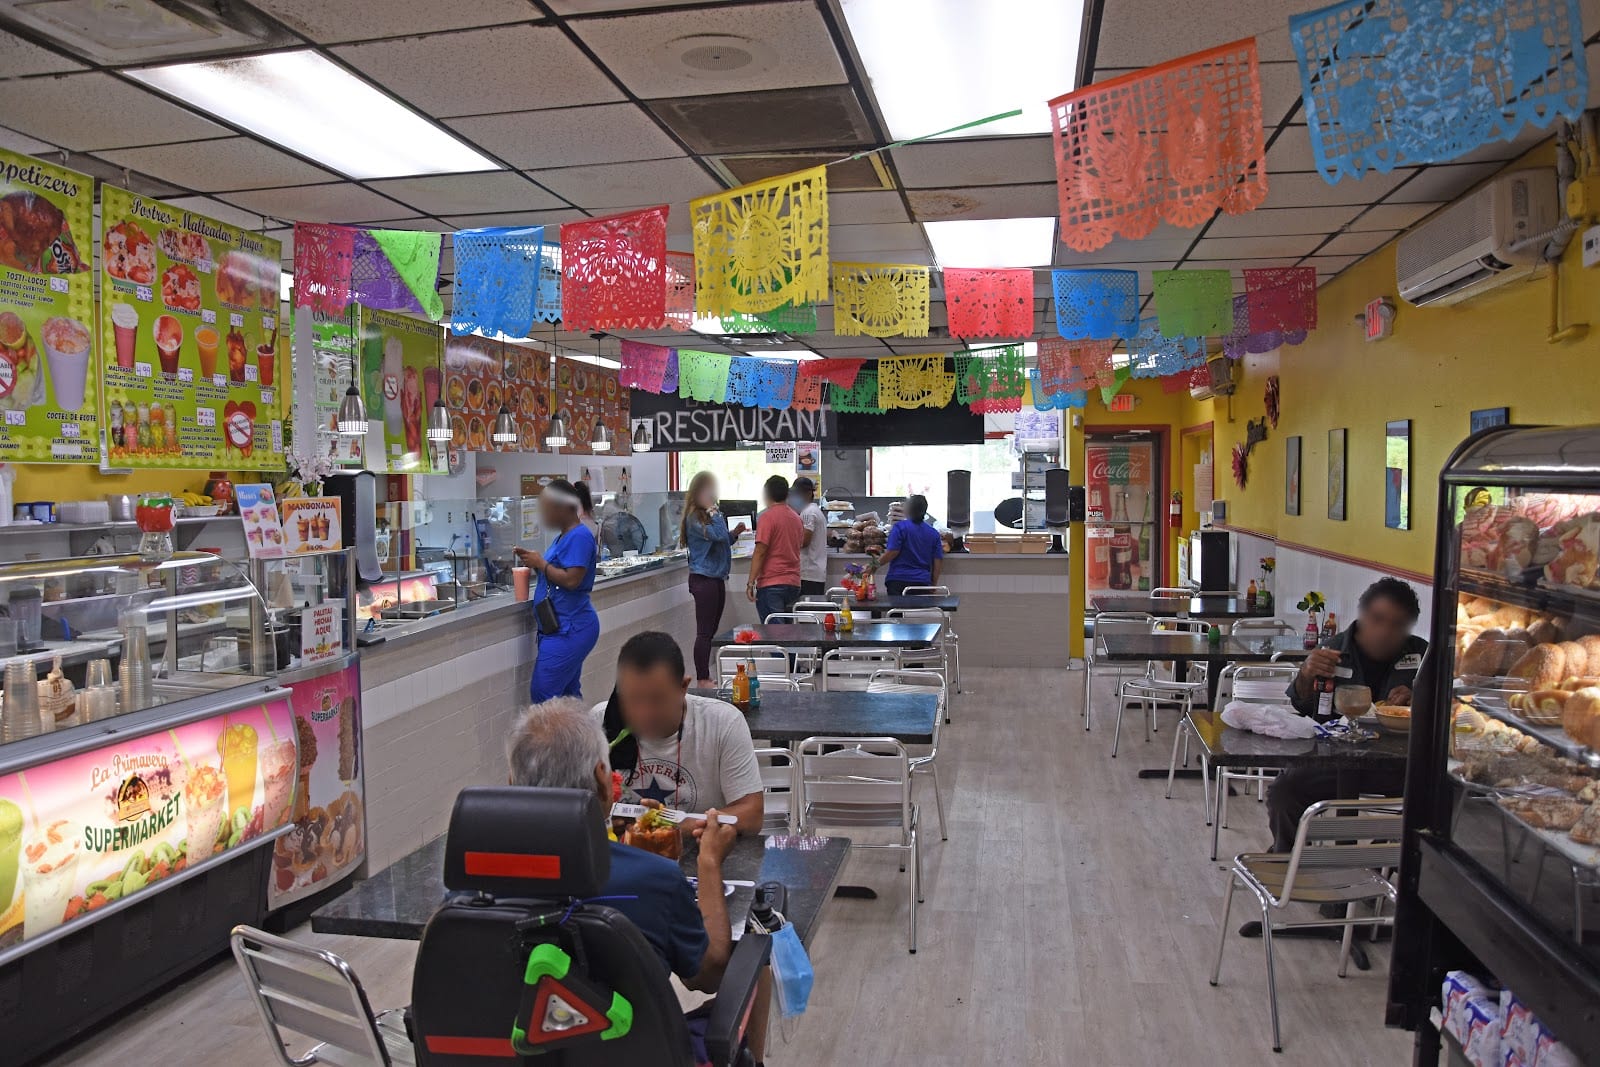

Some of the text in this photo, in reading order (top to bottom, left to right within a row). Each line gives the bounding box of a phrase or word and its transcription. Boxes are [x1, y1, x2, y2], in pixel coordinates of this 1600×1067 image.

[655, 404, 832, 445] RESTAURANT
[287, 502, 337, 511] MANGONADA
[112, 753, 169, 778] Primavera
[624, 764, 687, 788] CONVERSE
[85, 792, 182, 854] SUPERMARKET
